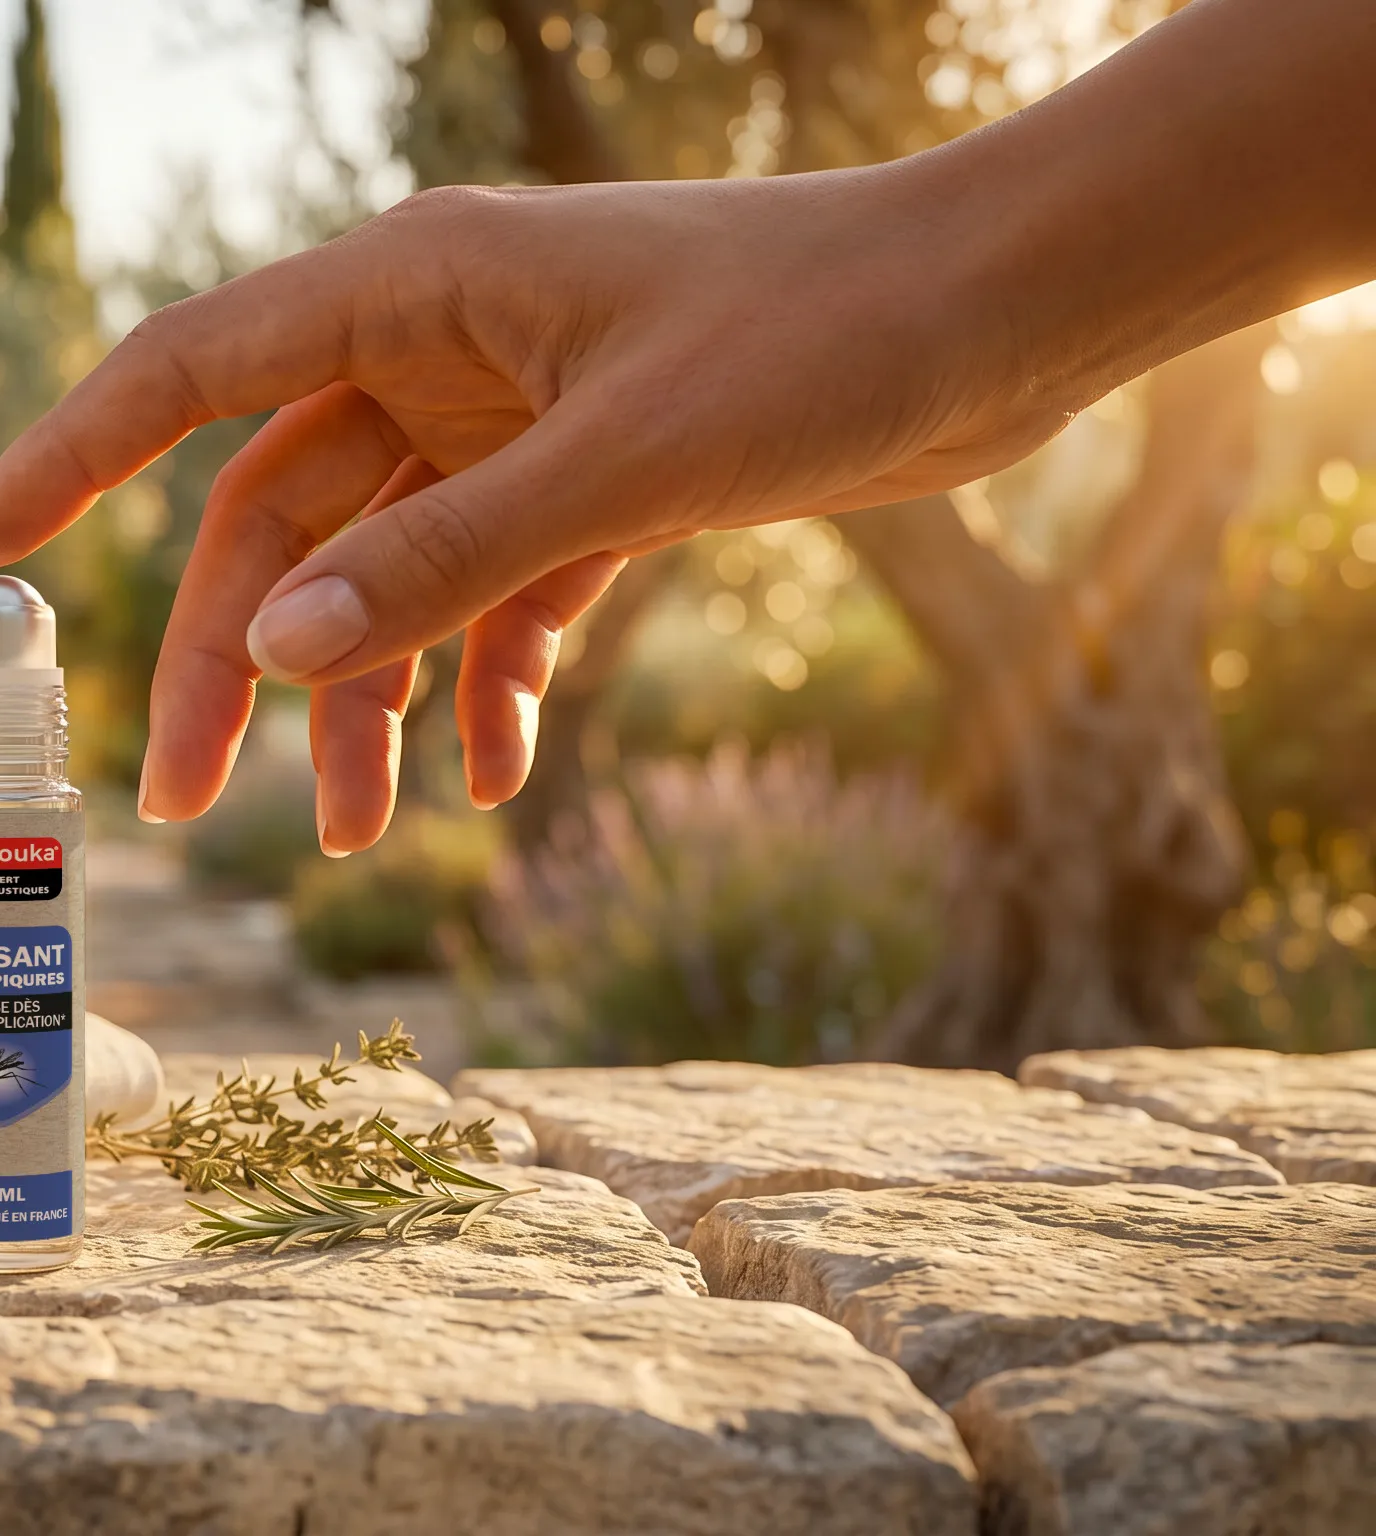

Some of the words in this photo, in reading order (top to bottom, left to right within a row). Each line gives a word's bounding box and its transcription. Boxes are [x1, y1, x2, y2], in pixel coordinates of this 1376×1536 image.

[13, 998, 40, 1014] DÈS
[11, 1211, 27, 1222] EN
[30, 1207, 68, 1222] FRANCE
